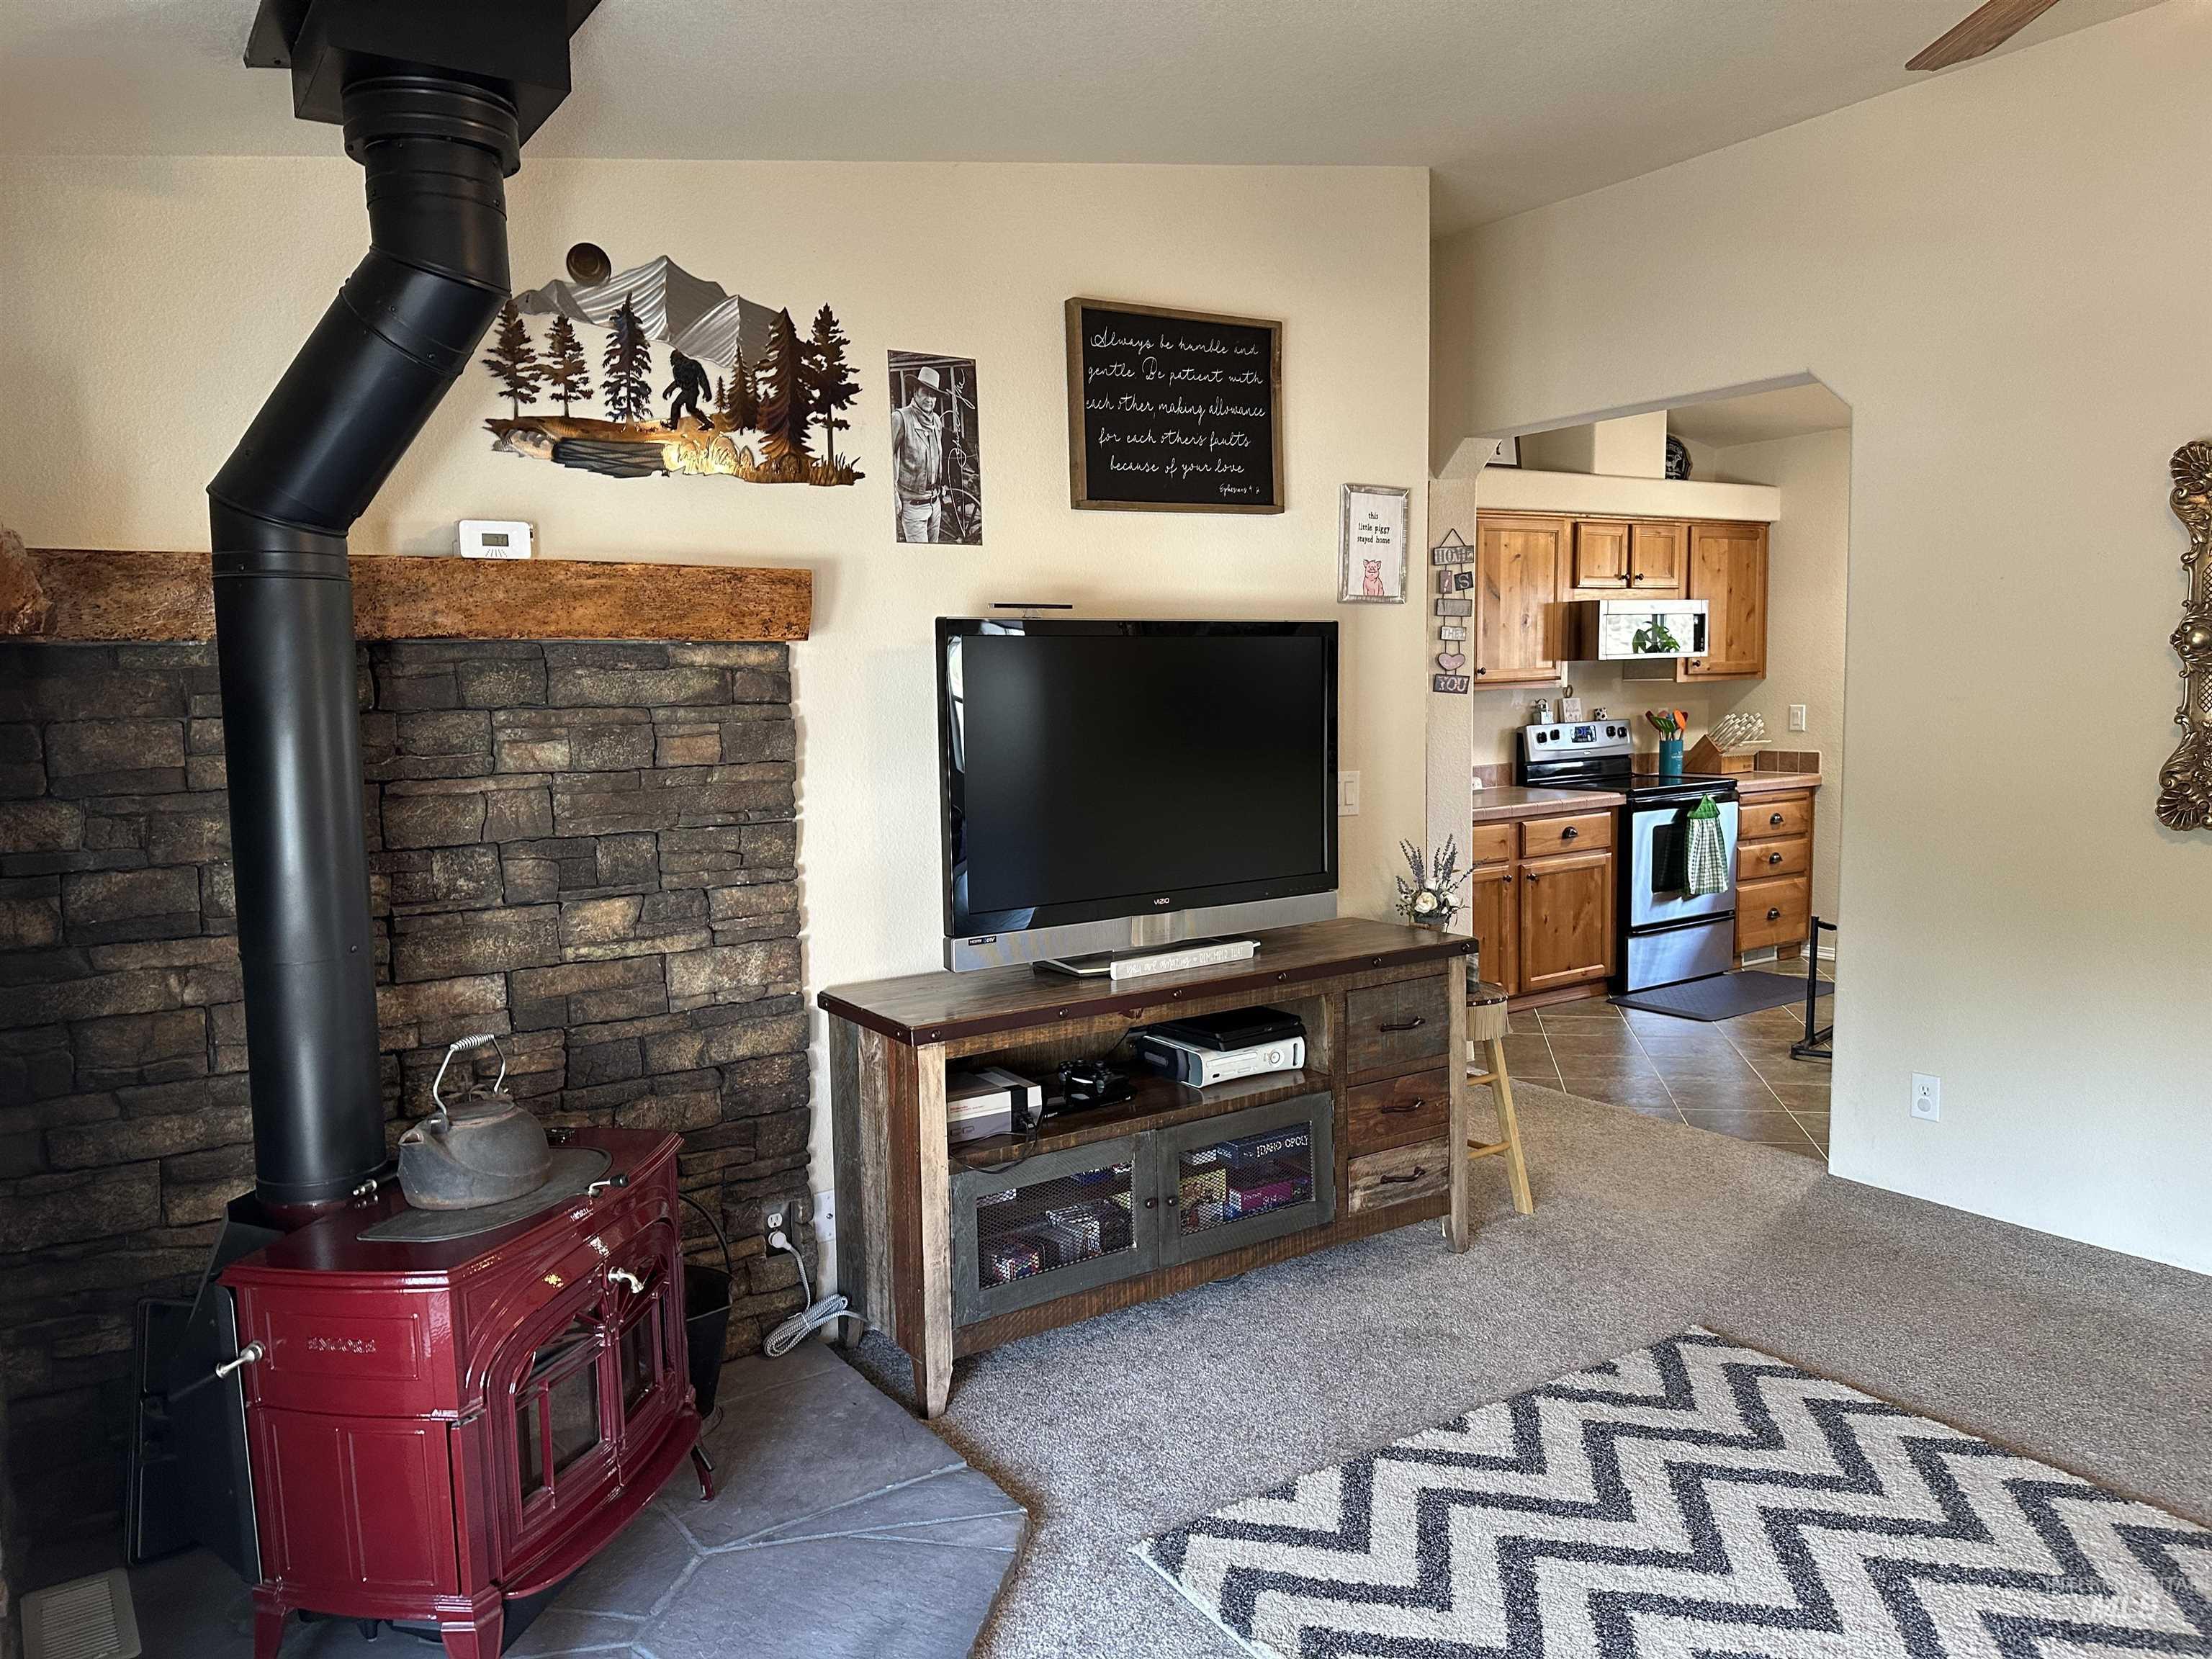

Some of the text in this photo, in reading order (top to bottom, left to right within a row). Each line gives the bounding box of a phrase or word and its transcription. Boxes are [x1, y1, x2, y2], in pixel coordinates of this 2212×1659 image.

[1090, 325, 1259, 355] Always be humble and
[1141, 356, 1165, 380] Be
[1169, 368, 1223, 387] patient
[1228, 371, 1263, 385] with
[1086, 392, 1114, 410] each
[1159, 397, 1206, 426] making
[1209, 396, 1266, 417] allowance
[1098, 427, 1121, 449] for
[1126, 428, 1156, 444] each
[1209, 431, 1251, 453] faults
[1110, 455, 1245, 480] because of your love
[1357, 535, 1372, 544] stayed
[1375, 524, 1390, 534] piggy
[1436, 548, 1473, 563] HOME
[1438, 676, 1468, 692] YOU
